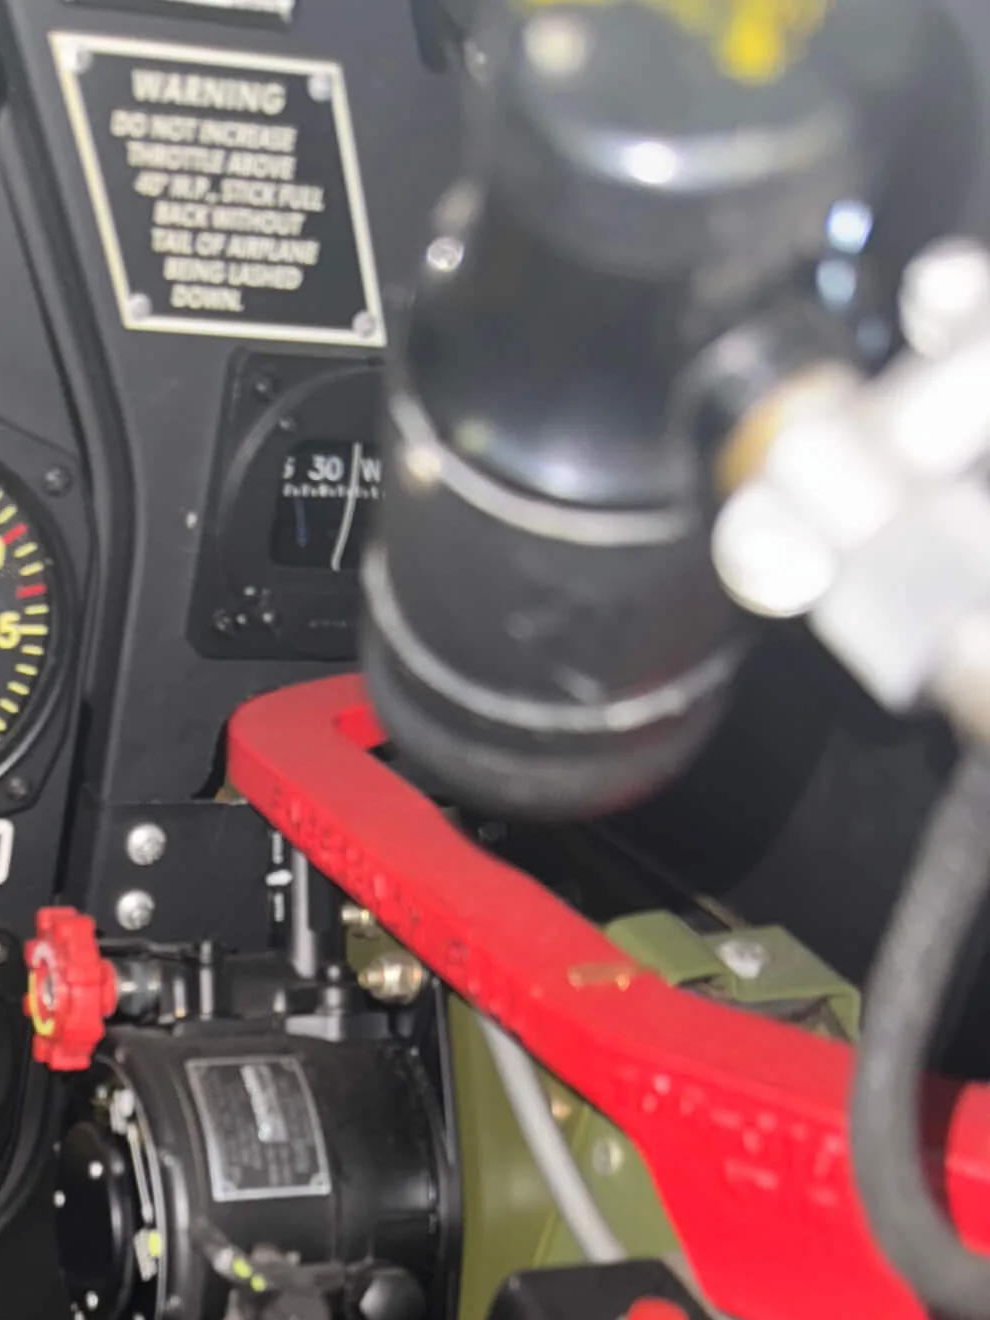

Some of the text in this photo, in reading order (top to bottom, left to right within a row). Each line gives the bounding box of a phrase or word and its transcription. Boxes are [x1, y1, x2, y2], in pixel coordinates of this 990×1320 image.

[131, 68, 286, 115] WARNING
[110, 109, 148, 138] DO
[149, 114, 197, 142] NOT
[126, 140, 297, 181] THROTTLE ABOVE
[153, 200, 306, 237] BACK WITHOUT
[150, 226, 320, 266] TAIL OF AIRPLANE
[163, 255, 304, 291] BEING LASHED
[307, 455, 344, 482] 30
